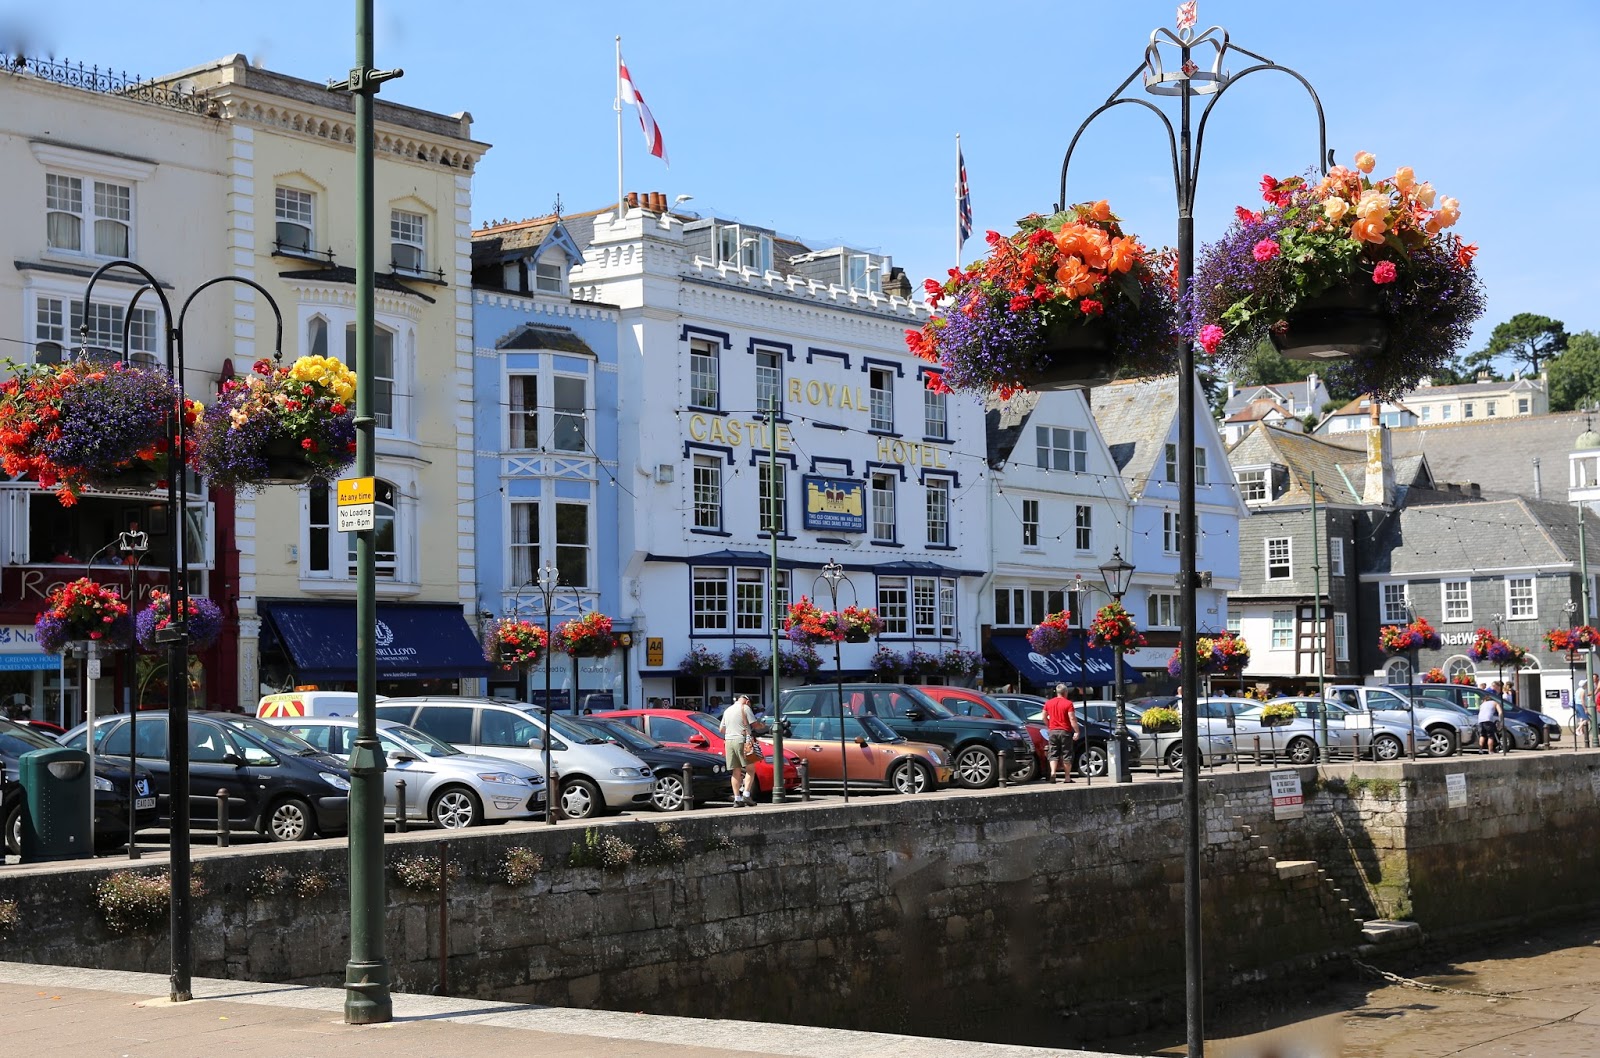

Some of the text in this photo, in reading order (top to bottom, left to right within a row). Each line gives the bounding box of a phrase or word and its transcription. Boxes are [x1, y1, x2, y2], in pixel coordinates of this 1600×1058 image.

[788, 377, 869, 412] ROYAL
[689, 414, 790, 452] CASTLE
[877, 438, 947, 468] HOTEL
[358, 492, 371, 500] time
[349, 509, 371, 517] Loading
[1440, 632, 1480, 646] NatWe
[387, 647, 417, 656] LLOYD
[649, 641, 662, 651] AA
